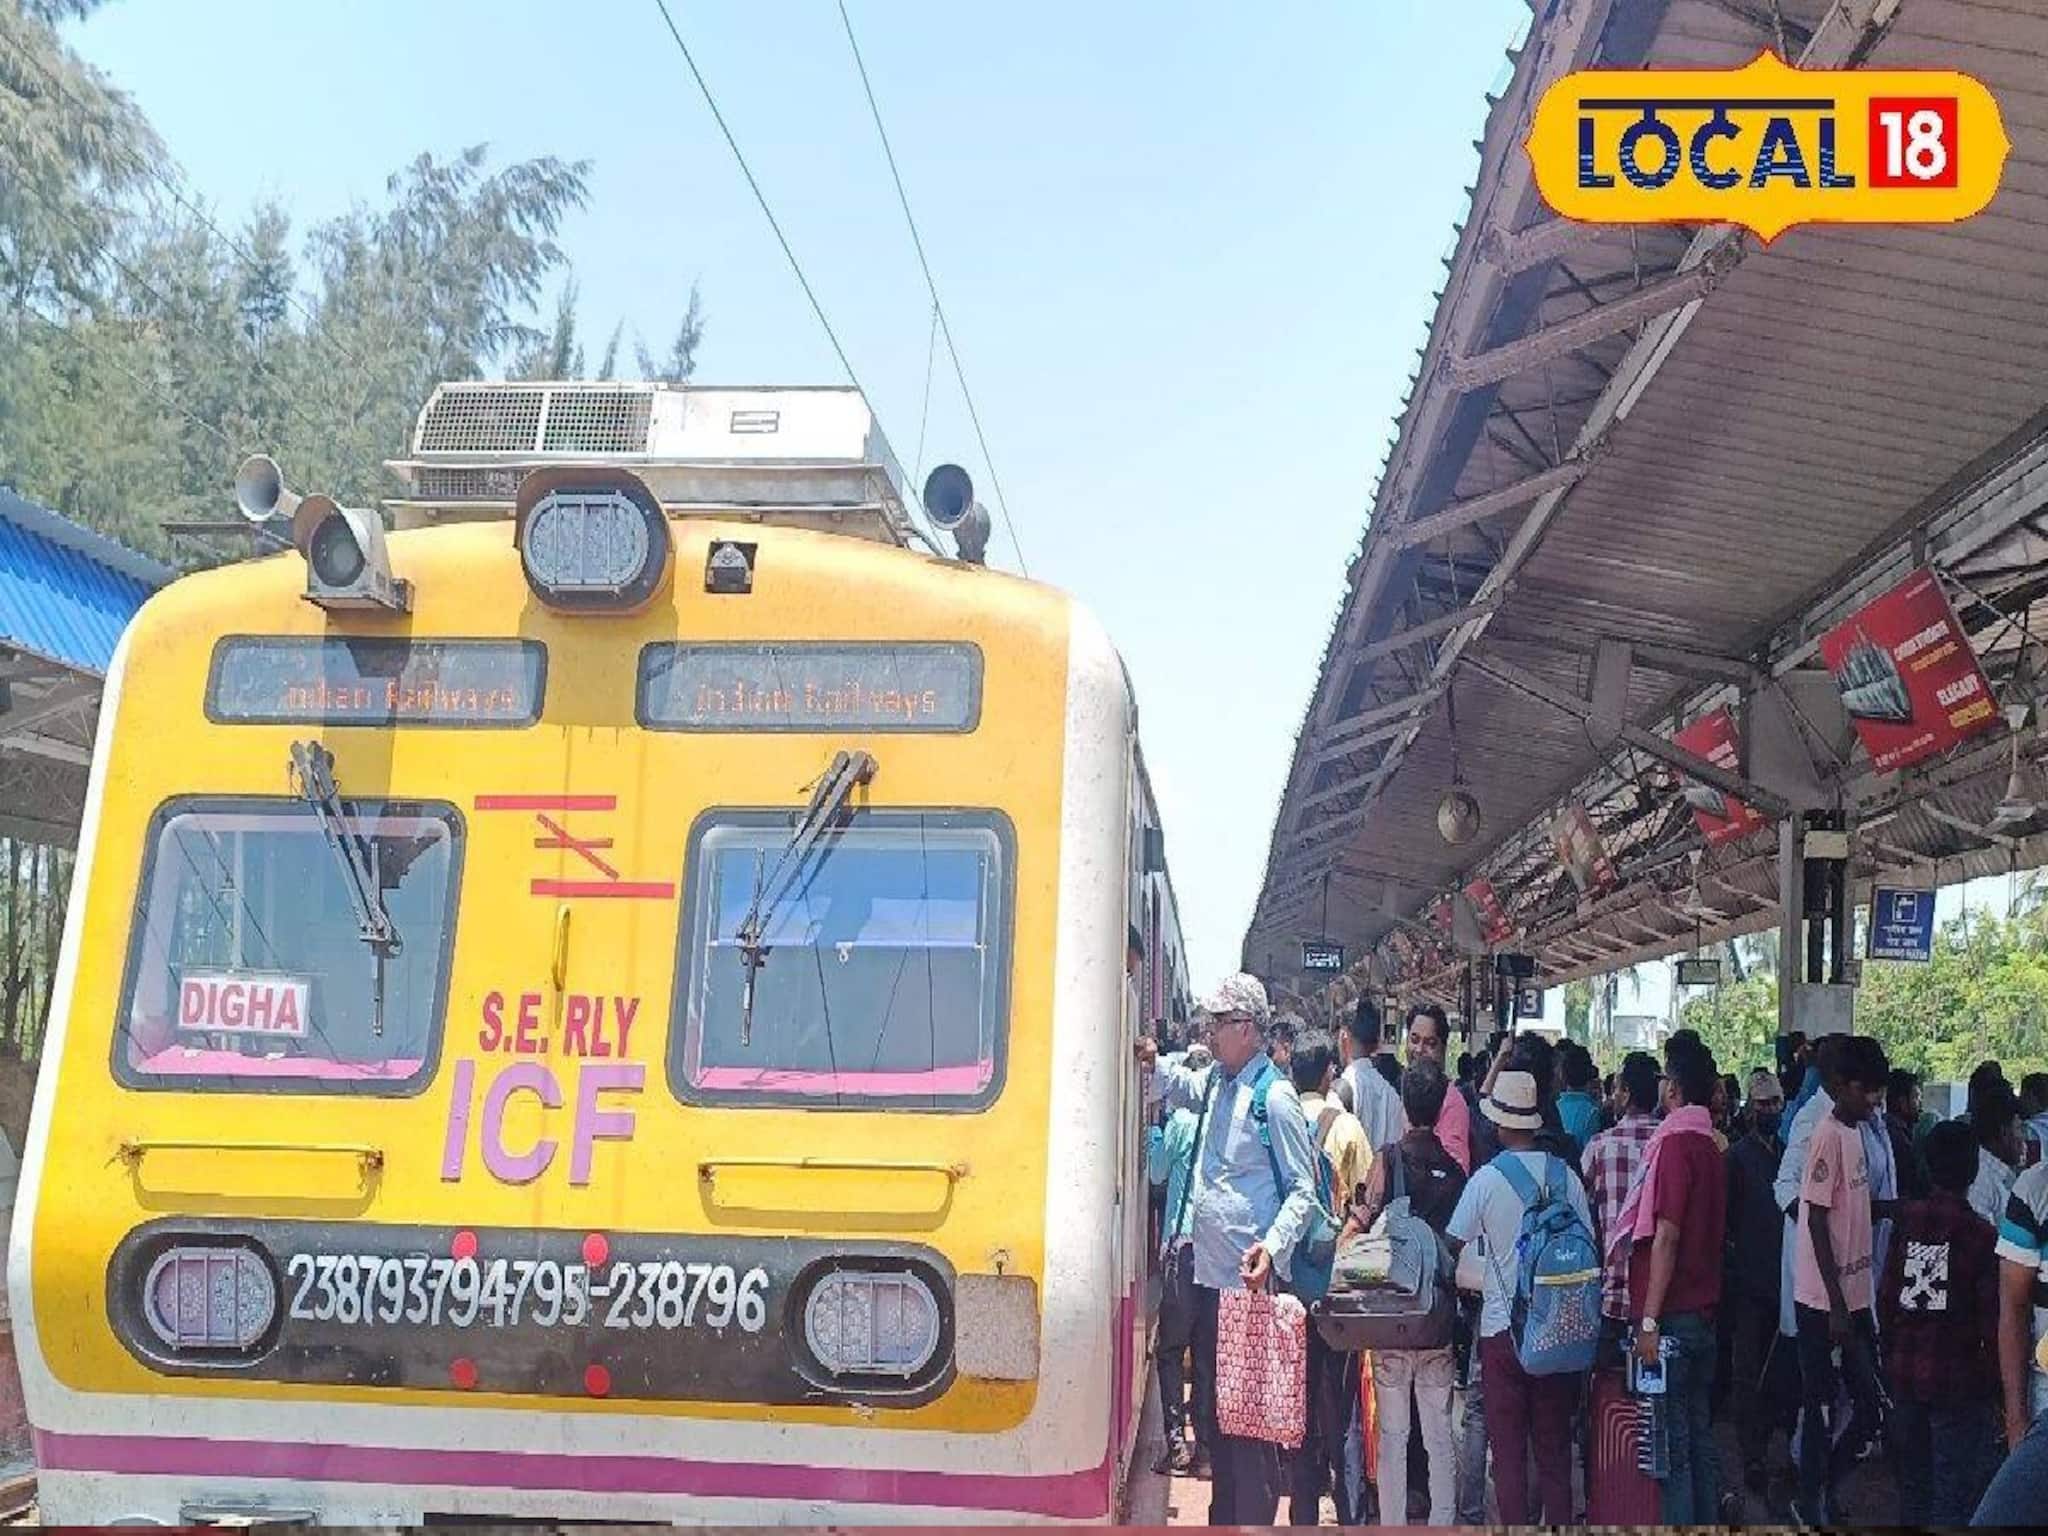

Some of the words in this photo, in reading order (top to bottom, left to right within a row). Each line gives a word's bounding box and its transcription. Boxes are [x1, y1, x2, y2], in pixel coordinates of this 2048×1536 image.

[284, 677, 371, 710] ndian
[182, 982, 299, 1031] DIGHA
[479, 991, 549, 1053] S.E.
[563, 995, 640, 1058] RLY
[1523, 989, 1537, 1013] 3
[441, 1060, 646, 1187] ICF
